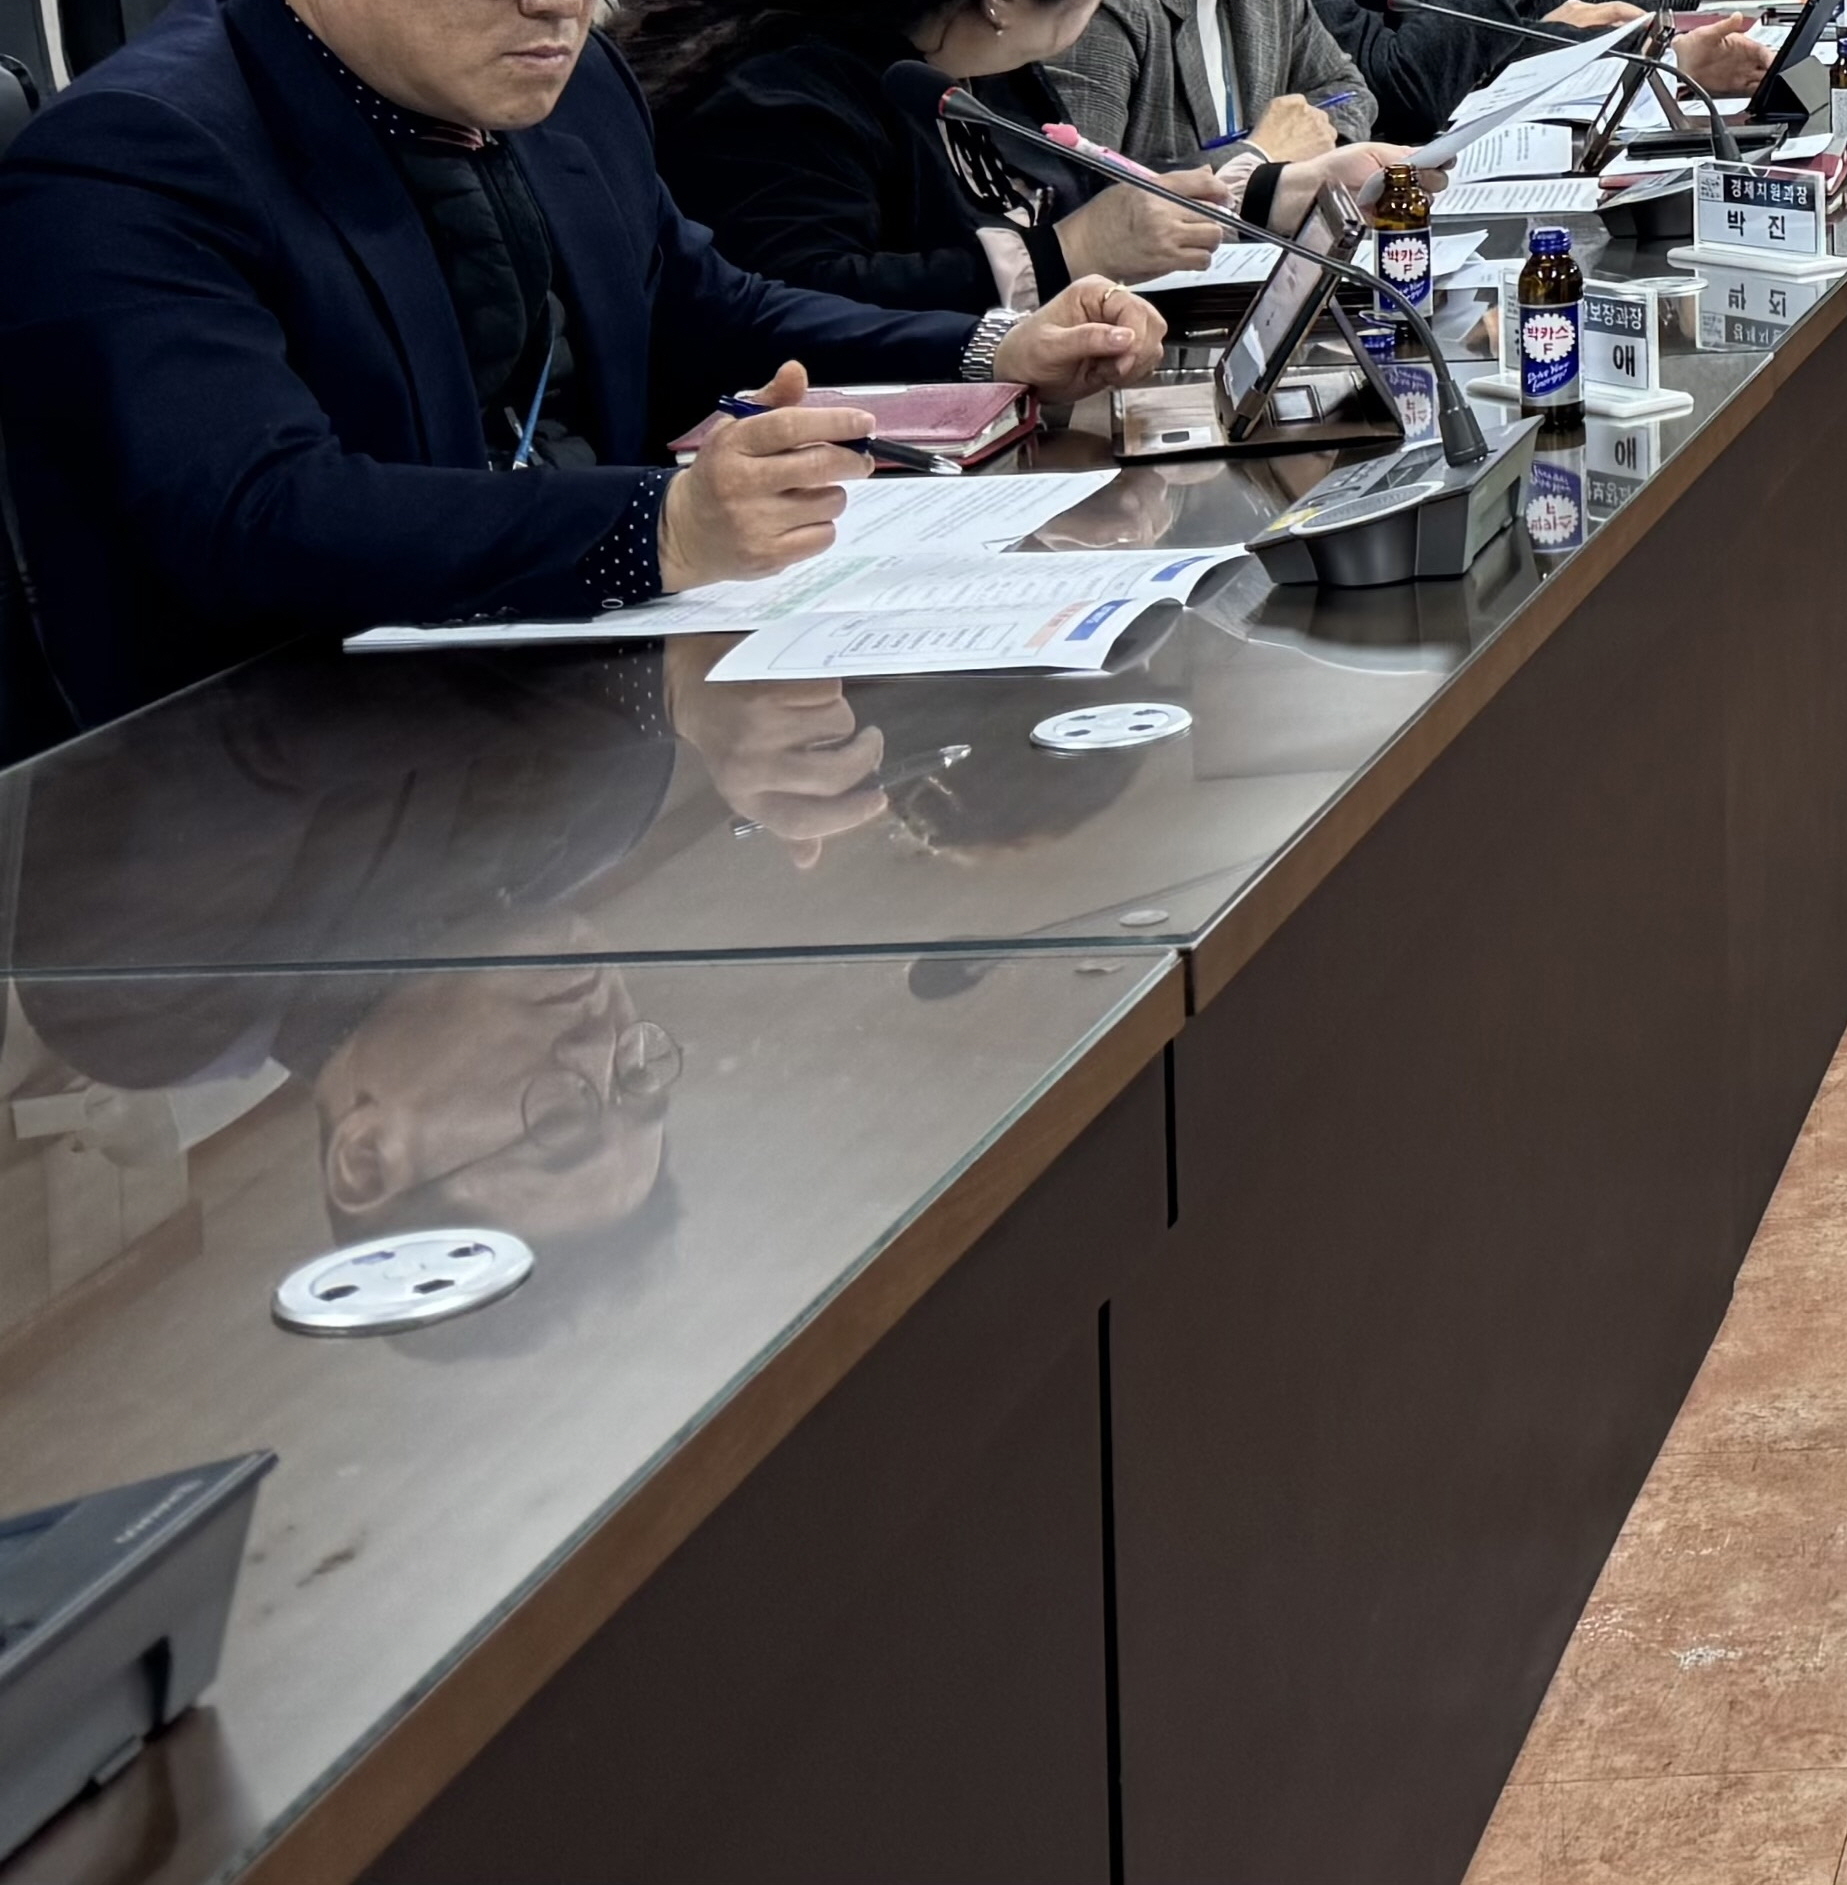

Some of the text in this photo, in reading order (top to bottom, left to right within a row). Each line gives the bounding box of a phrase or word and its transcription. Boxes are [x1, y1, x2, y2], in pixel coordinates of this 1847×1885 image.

[1730, 178, 1808, 206] 경제지원과장
[1387, 248, 1425, 264] 박카스
[1404, 264, 1413, 275] F
[1527, 325, 1570, 340] 박카스
[1543, 343, 1554, 356] F
